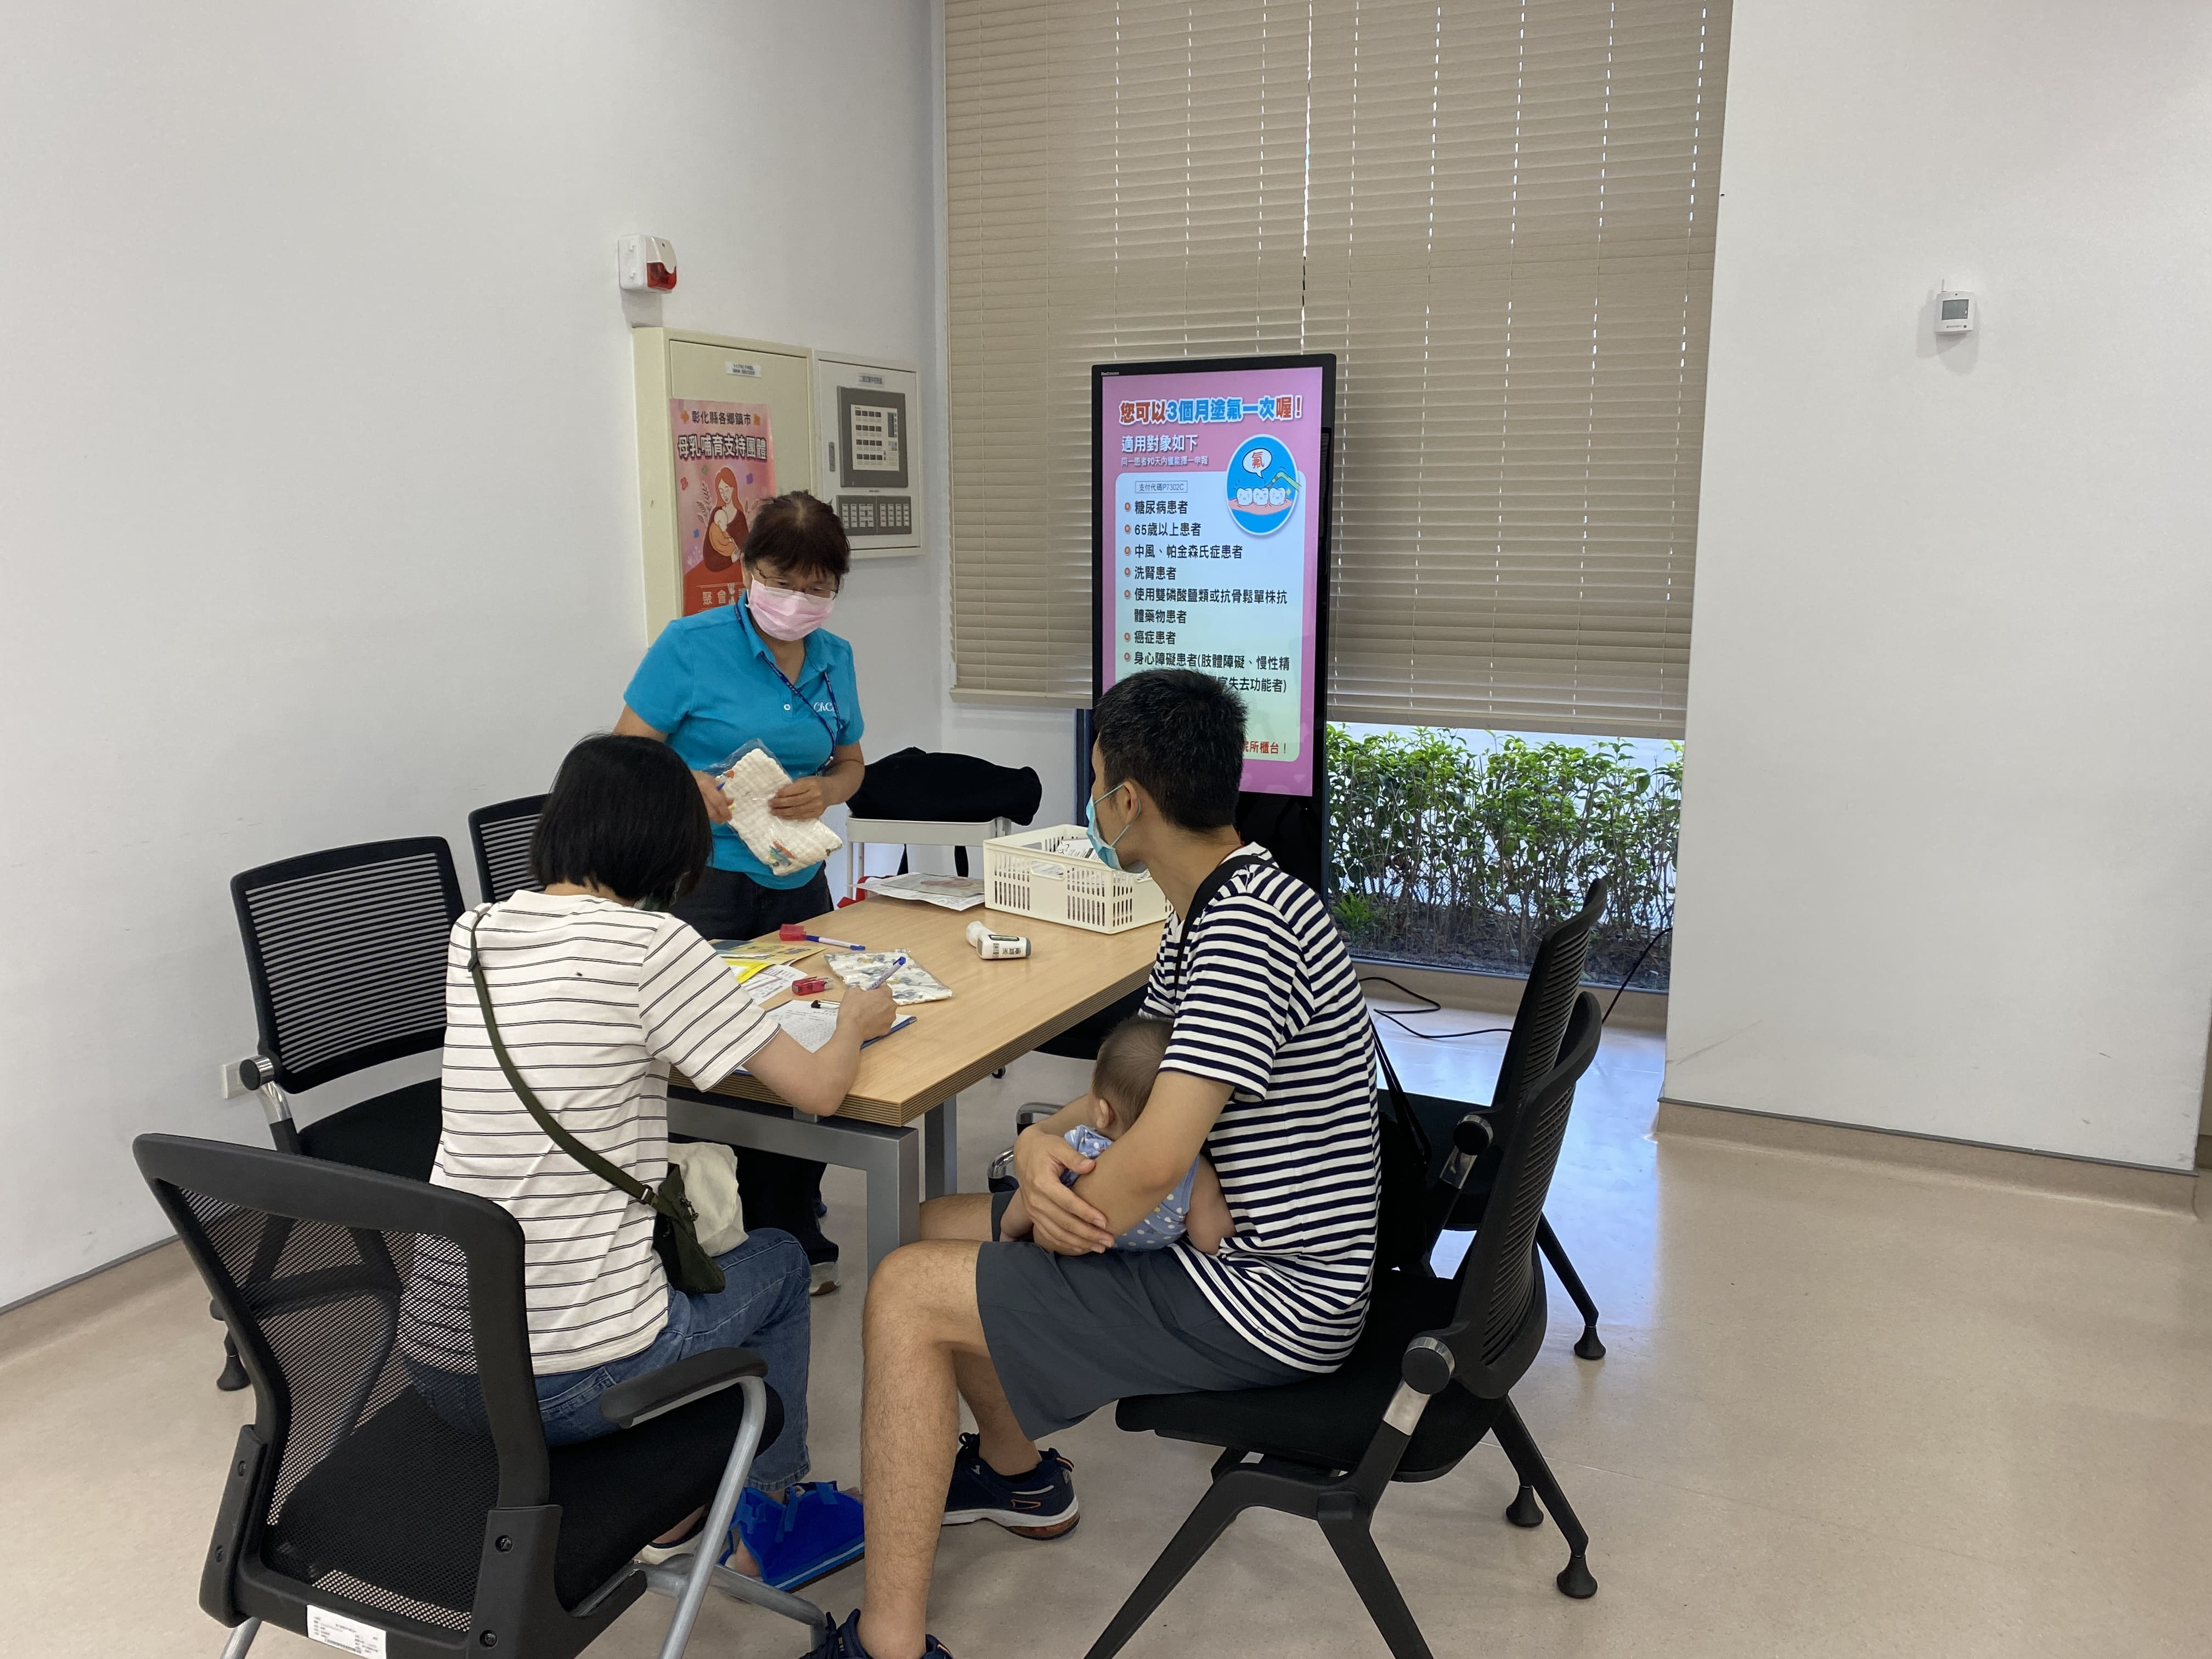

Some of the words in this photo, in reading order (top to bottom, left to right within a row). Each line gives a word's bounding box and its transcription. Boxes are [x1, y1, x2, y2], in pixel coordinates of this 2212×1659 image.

[692, 411, 751, 426] 彰化縣各鄉鎮市
[678, 433, 768, 461] 母乳哺育支持團體
[1122, 434, 1198, 453] 適用對象如下
[1252, 452, 1264, 469] 氟
[1139, 483, 1184, 492] 支付代碼P7302C
[1135, 500, 1188, 515] 糖尿病患者
[1135, 522, 1201, 537] 65歲以上患者
[1135, 544, 1243, 559] 中風、帕金森氏症患者
[1135, 566, 1176, 580] 洗腎患者
[1135, 587, 1287, 604] 使用雙磷酸鹽類或抗骨鬆單株抗
[1134, 608, 1187, 624] 體藥物患者
[1134, 630, 1176, 645] 癌症患者
